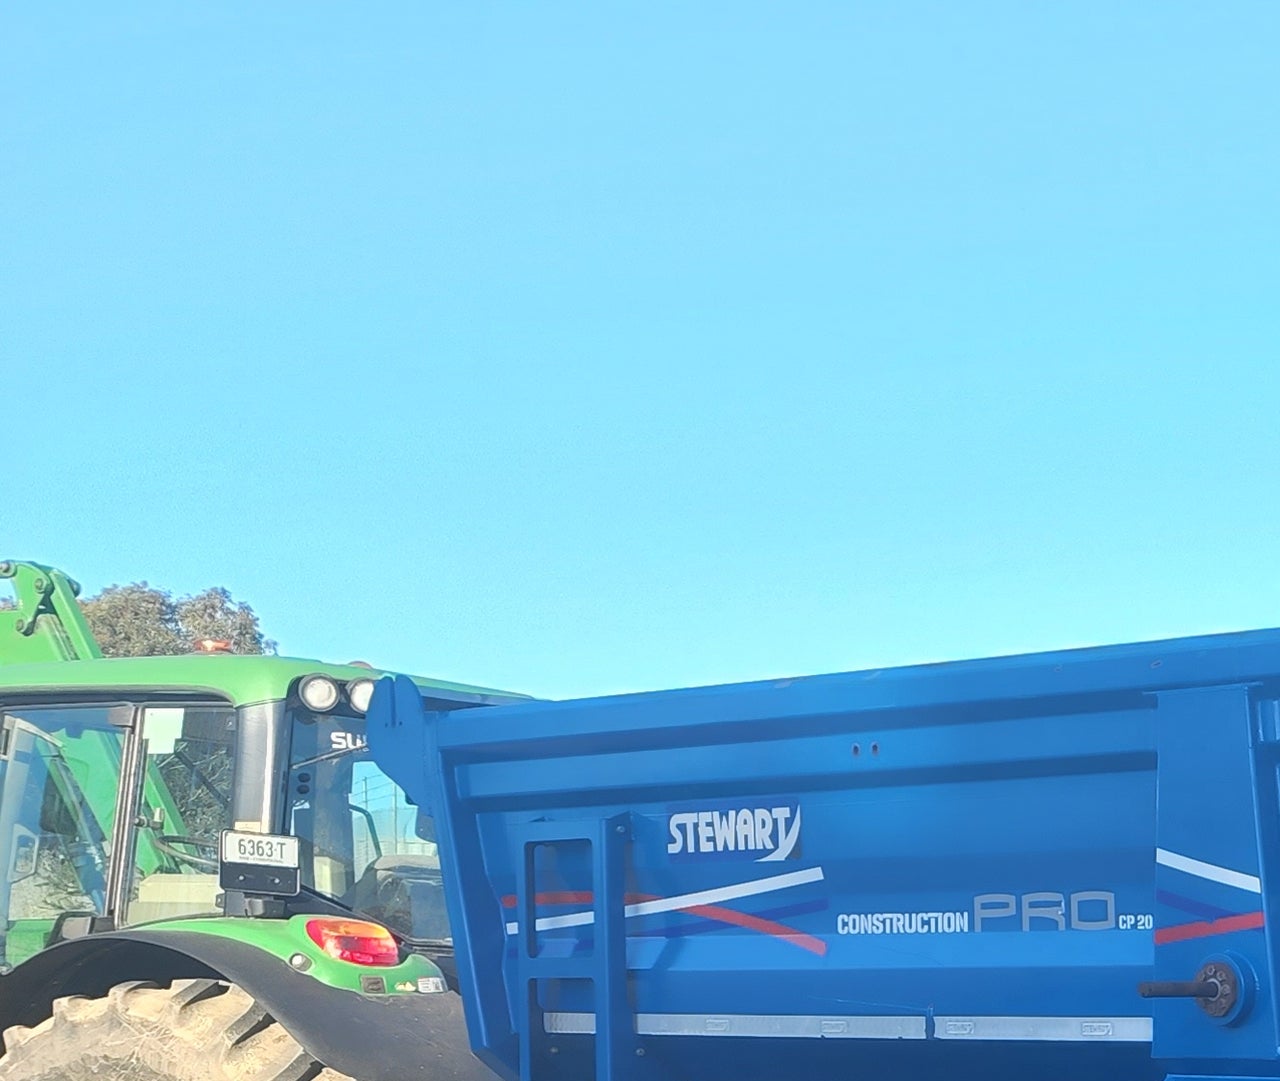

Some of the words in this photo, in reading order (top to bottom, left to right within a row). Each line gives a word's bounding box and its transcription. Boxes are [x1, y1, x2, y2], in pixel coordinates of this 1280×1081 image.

[667, 803, 801, 862] STEWART
[837, 911, 969, 935] CONSTRUCTION
[973, 891, 1116, 933] PRO
[1118, 915, 1135, 930] CP
[1137, 914, 1153, 930] 20
